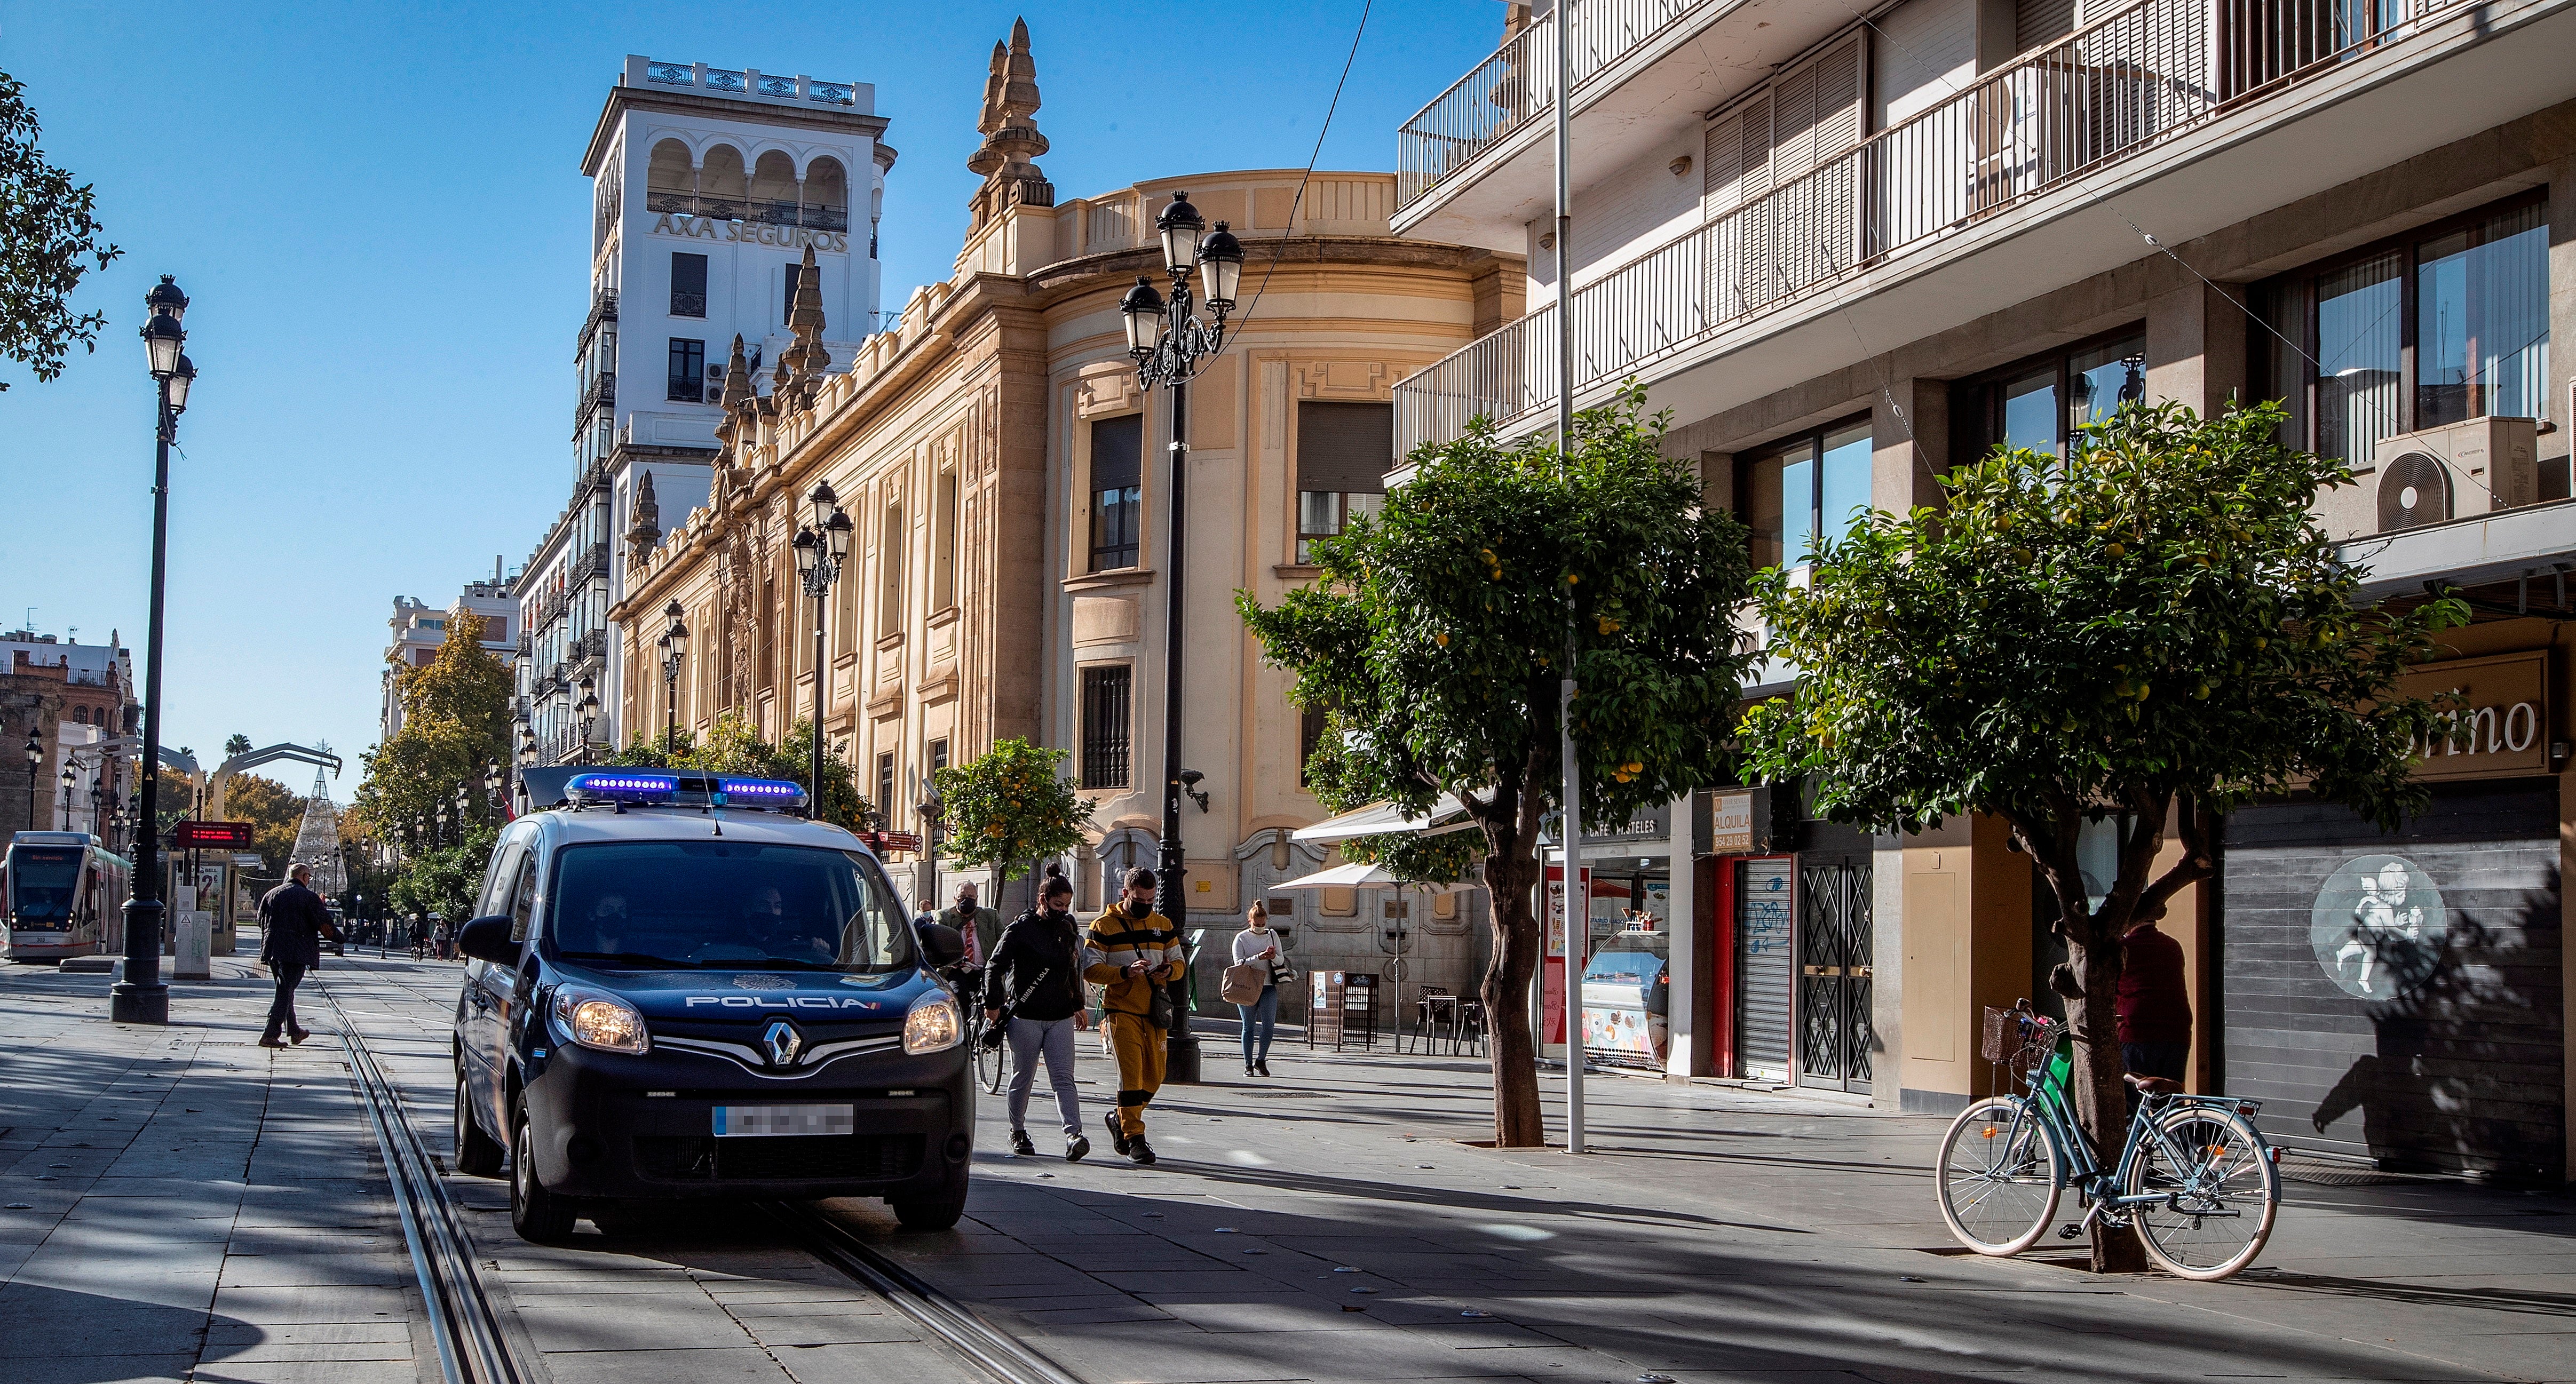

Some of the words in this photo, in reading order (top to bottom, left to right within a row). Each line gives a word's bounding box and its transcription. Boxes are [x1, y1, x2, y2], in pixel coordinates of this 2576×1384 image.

[654, 213, 717, 239] AXA
[726, 220, 849, 252] SEGUROS
[1714, 814, 1750, 830] ALQUILA
[1716, 837, 1725, 847] 954
[1726, 836, 1733, 846] 29
[1734, 835, 1741, 846] 02
[1742, 834, 1749, 845] 52
[1020, 985, 1035, 1003] BIMBA
[1036, 967, 1050, 981] LOLA
[685, 996, 869, 1008] POLICÍA
